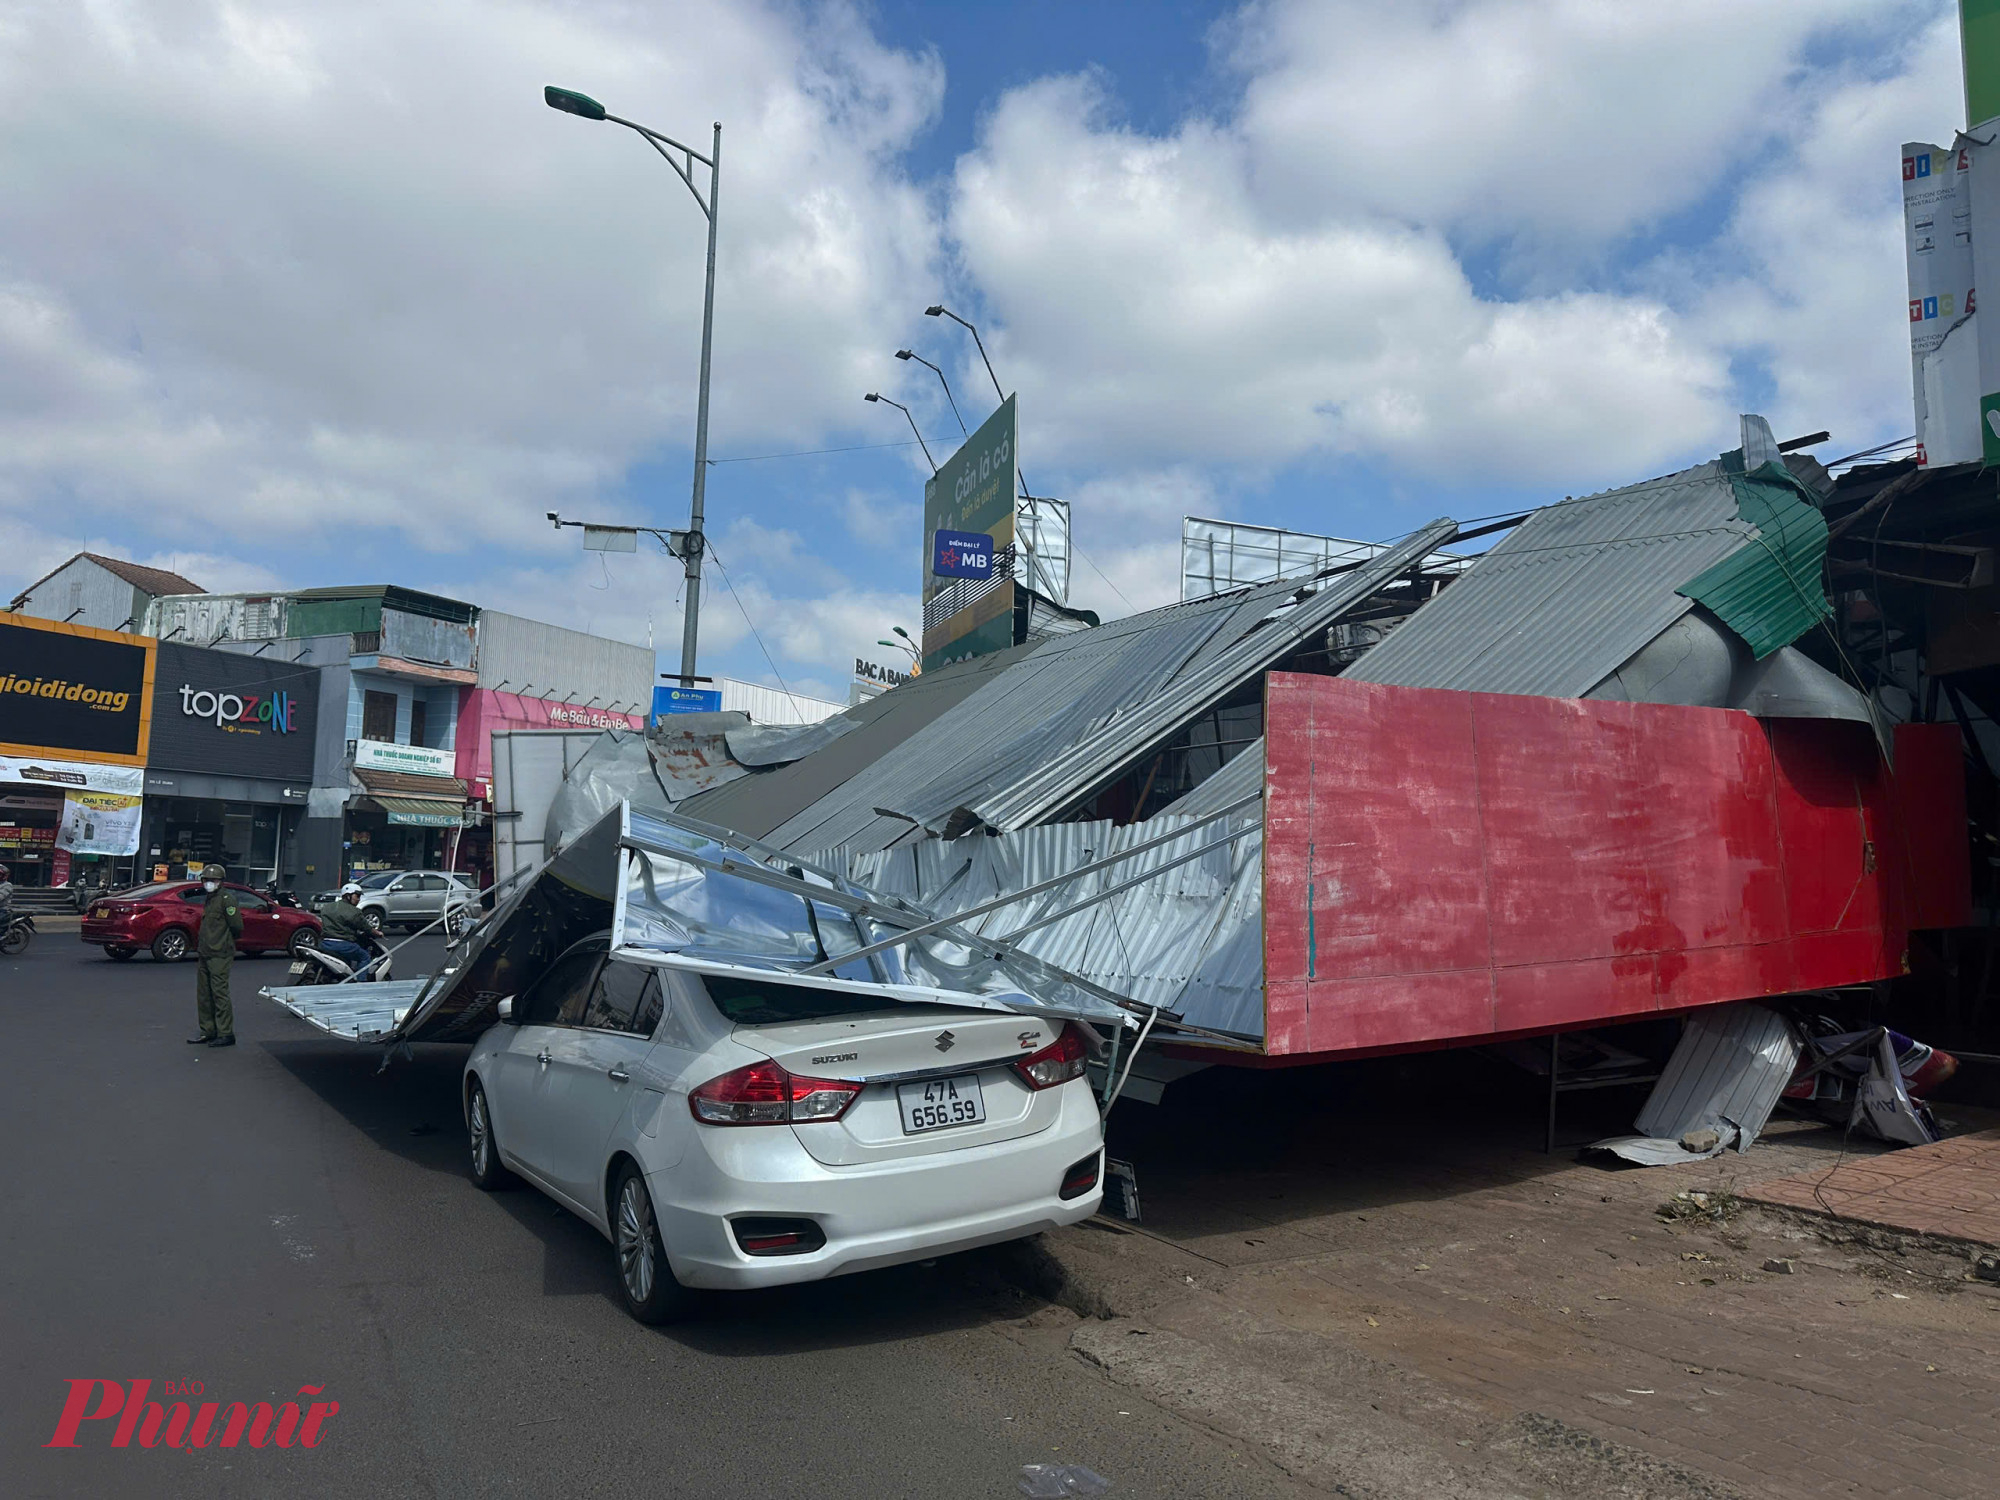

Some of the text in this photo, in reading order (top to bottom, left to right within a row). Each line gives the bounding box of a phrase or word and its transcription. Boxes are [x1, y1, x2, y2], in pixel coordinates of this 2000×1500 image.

[955, 461, 976, 503] Cần
[979, 450, 990, 483] là
[993, 429, 1009, 470] có
[973, 541, 980, 549] LÝ
[961, 552, 987, 568] MB
[856, 658, 878, 679] BAC
[878, 666, 887, 682] A
[89, 703, 110, 711] .com
[591, 714, 599, 727] &
[600, 715, 615, 729] Em
[373, 748, 383, 757] NHÀ
[383, 750, 398, 758] THUỐC
[419, 814, 448, 825] THUỐC
[811, 1052, 858, 1065] SUZUKI
[924, 1080, 958, 1103] 47A
[912, 1100, 976, 1128] 656.59
